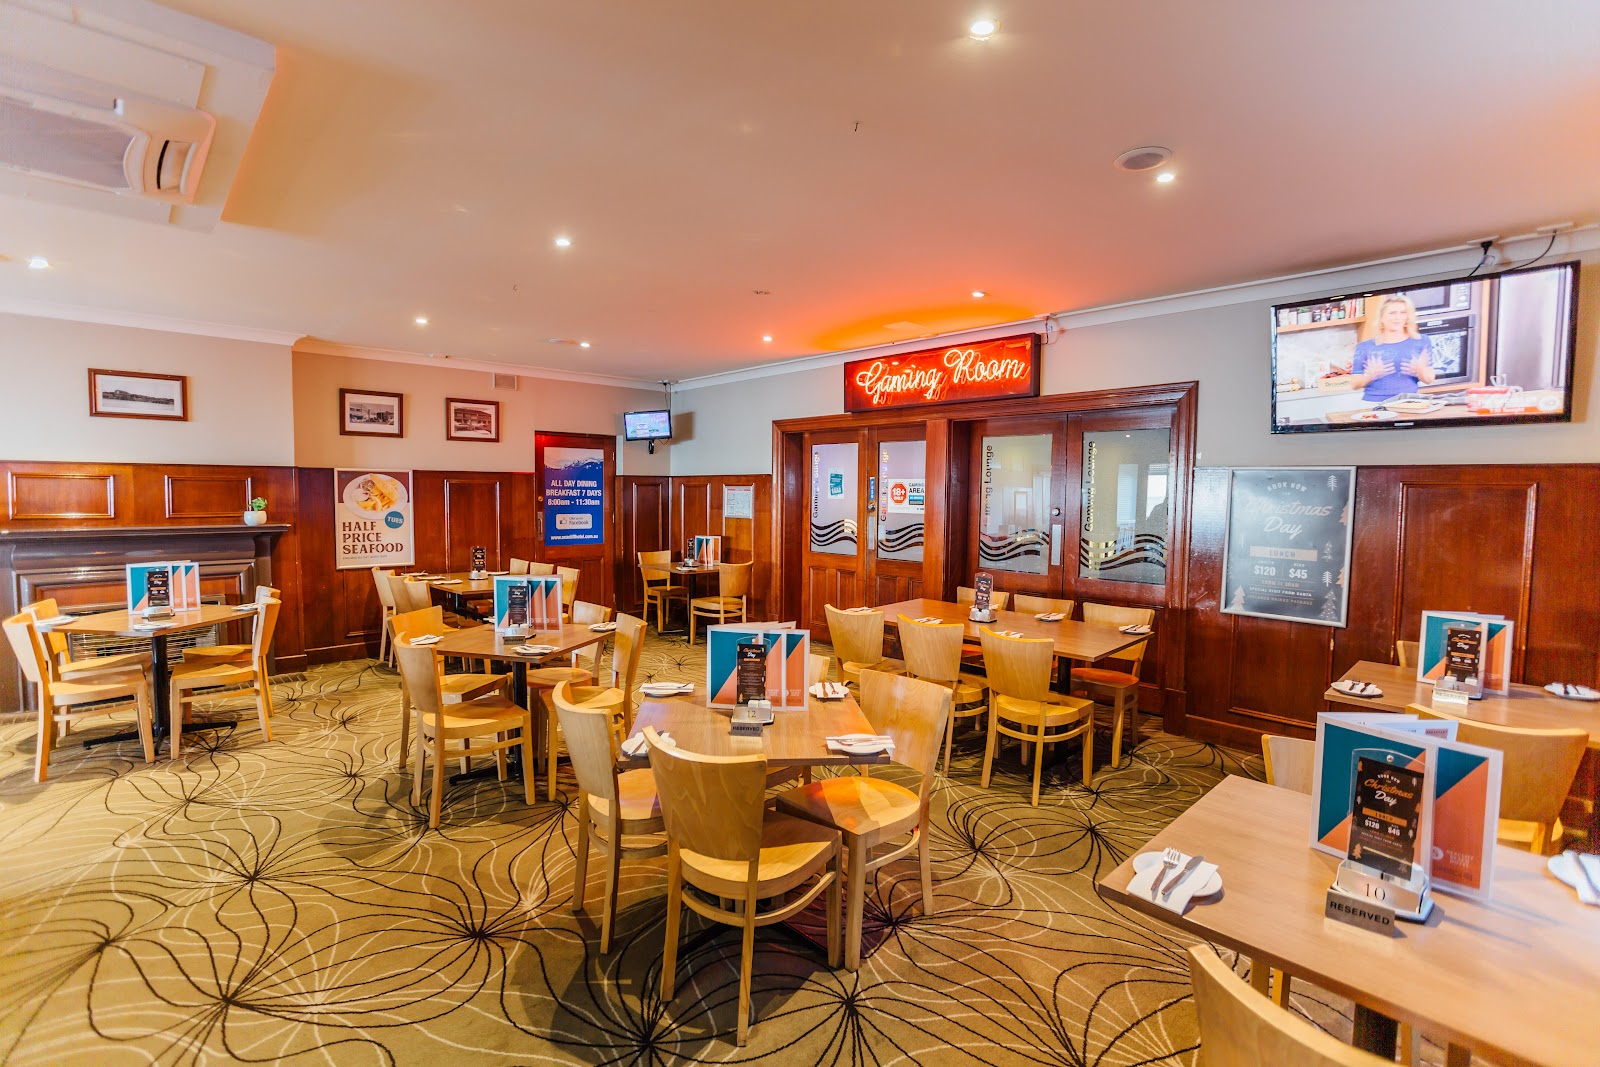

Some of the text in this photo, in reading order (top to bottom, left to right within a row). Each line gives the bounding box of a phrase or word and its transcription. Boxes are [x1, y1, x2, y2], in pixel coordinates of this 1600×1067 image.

[856, 349, 1025, 404] Gaming Room
[576, 480, 597, 488] DINING
[984, 445, 994, 527] ming Lounge
[1084, 440, 1097, 532] Gaming Lounge
[1266, 482, 1307, 492] BOOK NOW
[545, 489, 581, 497] BREAKFAST
[892, 488, 906, 496] 18+
[387, 516, 404, 524] TUES
[342, 521, 377, 532] HALF
[1264, 516, 1302, 540] Day
[342, 532, 382, 543] PRICE
[342, 542, 404, 555] SEAFOOD
[1269, 550, 1296, 558] LUNCH
[1254, 564, 1276, 576] $120
[1288, 567, 1308, 579] $45
[1364, 778, 1414, 799] Christmas
[1374, 790, 1397, 807] Day
[1364, 819, 1380, 830] $120
[1365, 883, 1386, 901] 10
[1330, 901, 1390, 925] RESERVED
